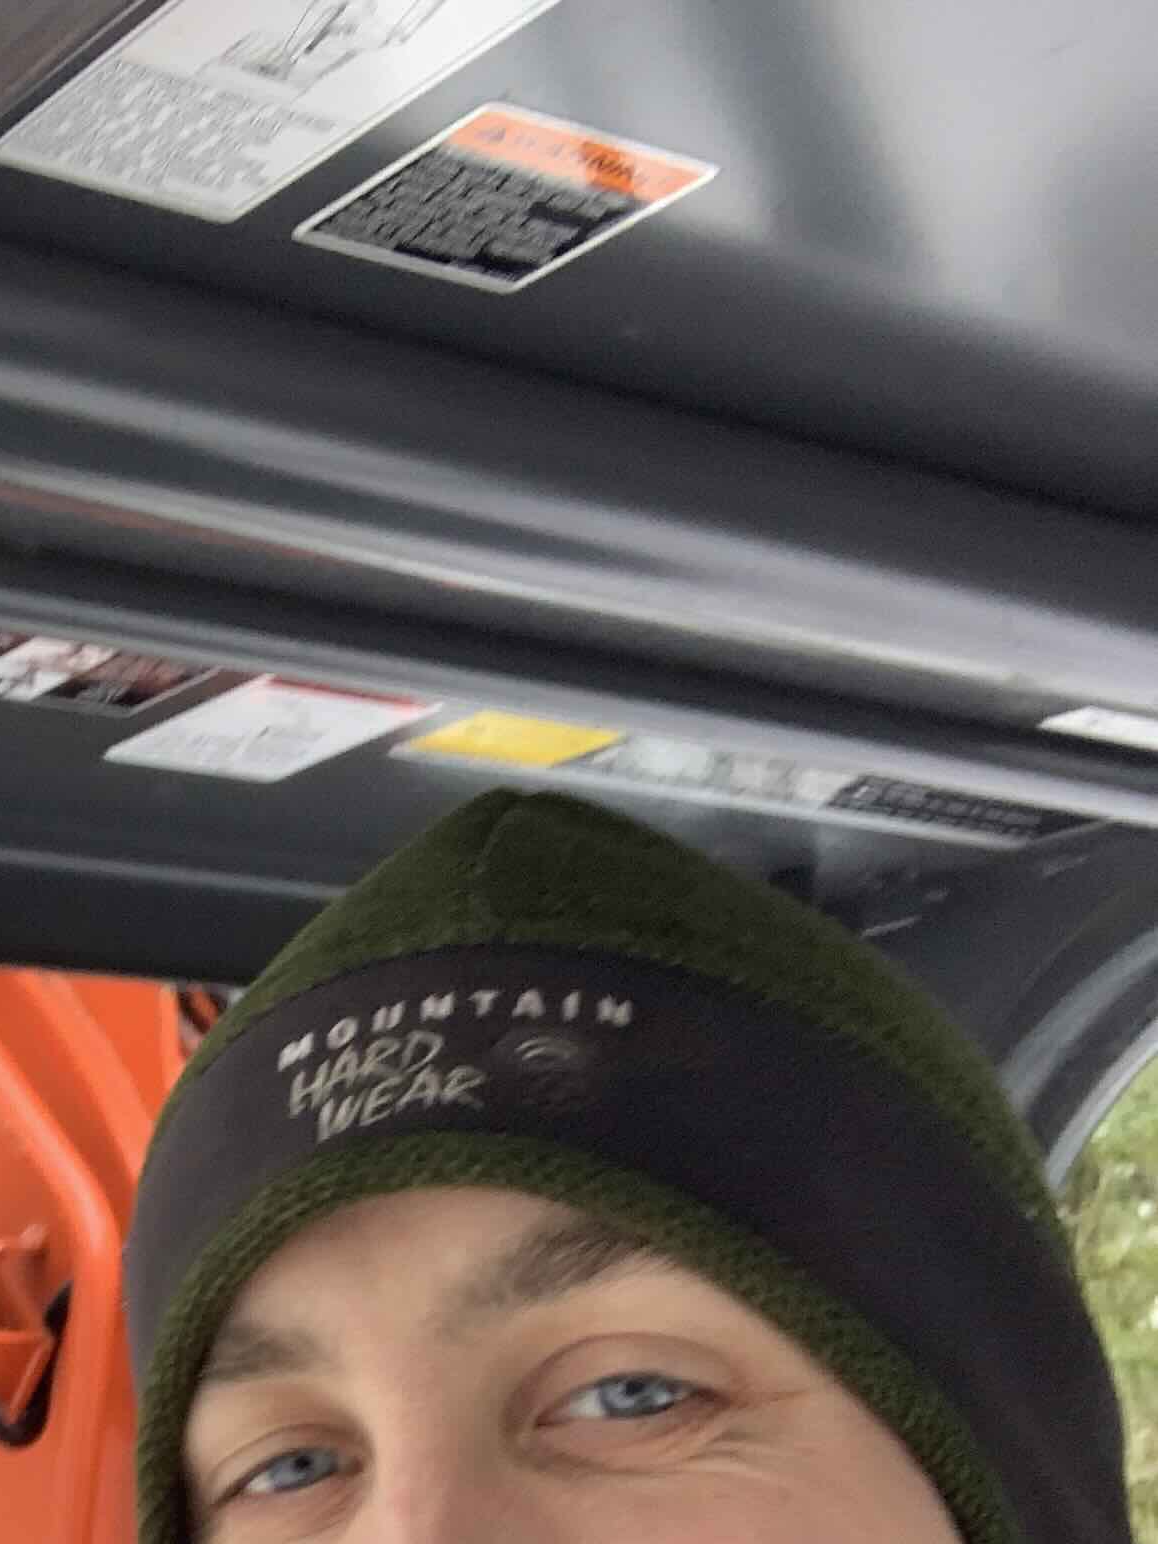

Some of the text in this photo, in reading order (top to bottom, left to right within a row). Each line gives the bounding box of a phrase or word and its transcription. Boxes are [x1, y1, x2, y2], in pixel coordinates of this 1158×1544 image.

[277, 988, 633, 1071] MOUNTAIN
[289, 1029, 443, 1118] HARD
[317, 1064, 488, 1143] WEAR
